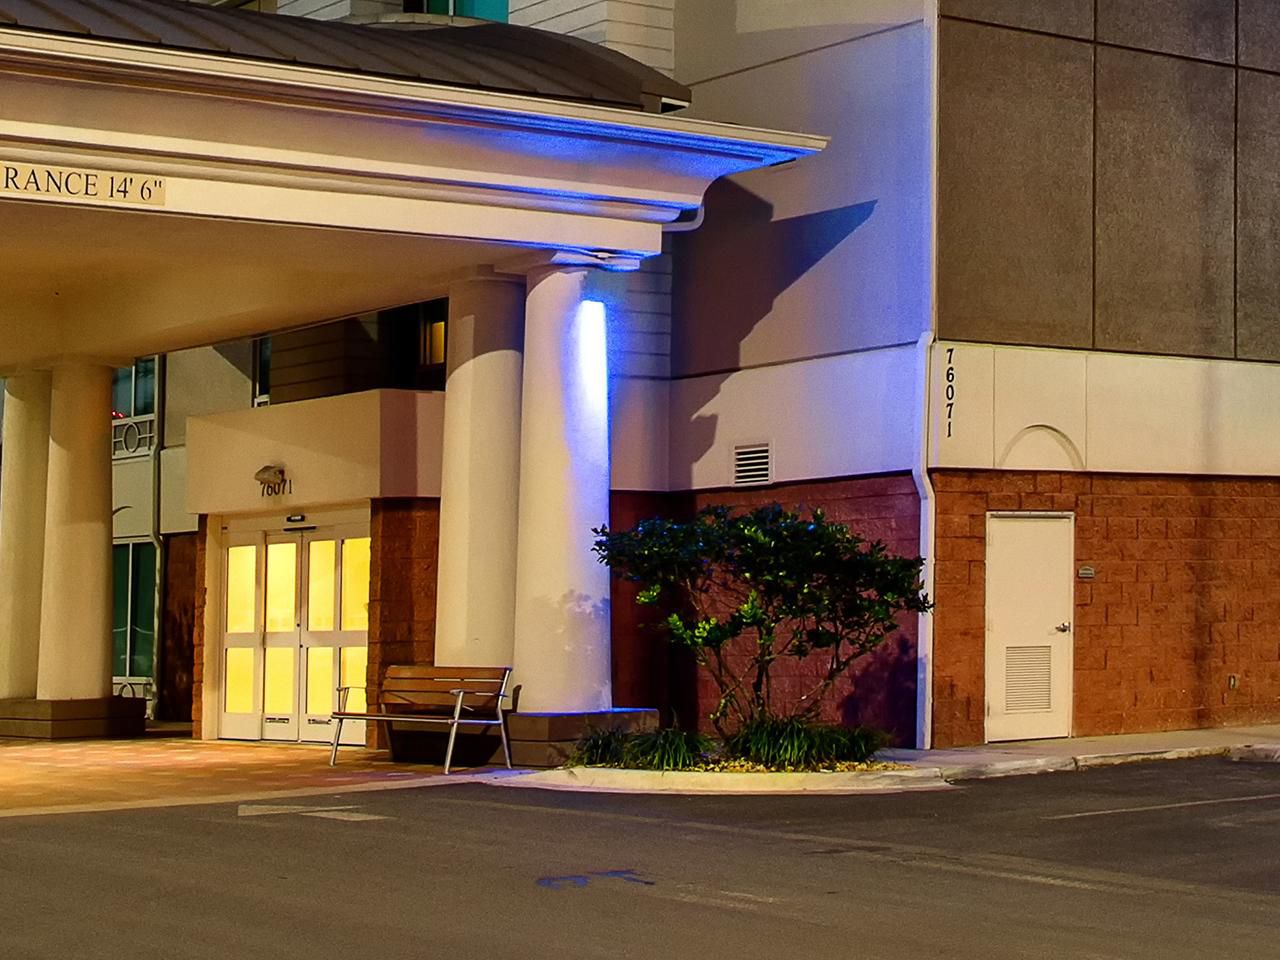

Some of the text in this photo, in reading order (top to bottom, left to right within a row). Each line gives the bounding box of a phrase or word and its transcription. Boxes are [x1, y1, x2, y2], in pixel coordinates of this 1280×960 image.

[108, 176, 133, 199] 14'
[140, 179, 162, 200] 6"
[946, 348, 954, 438] 76071
[260, 479, 292, 496] 76071
